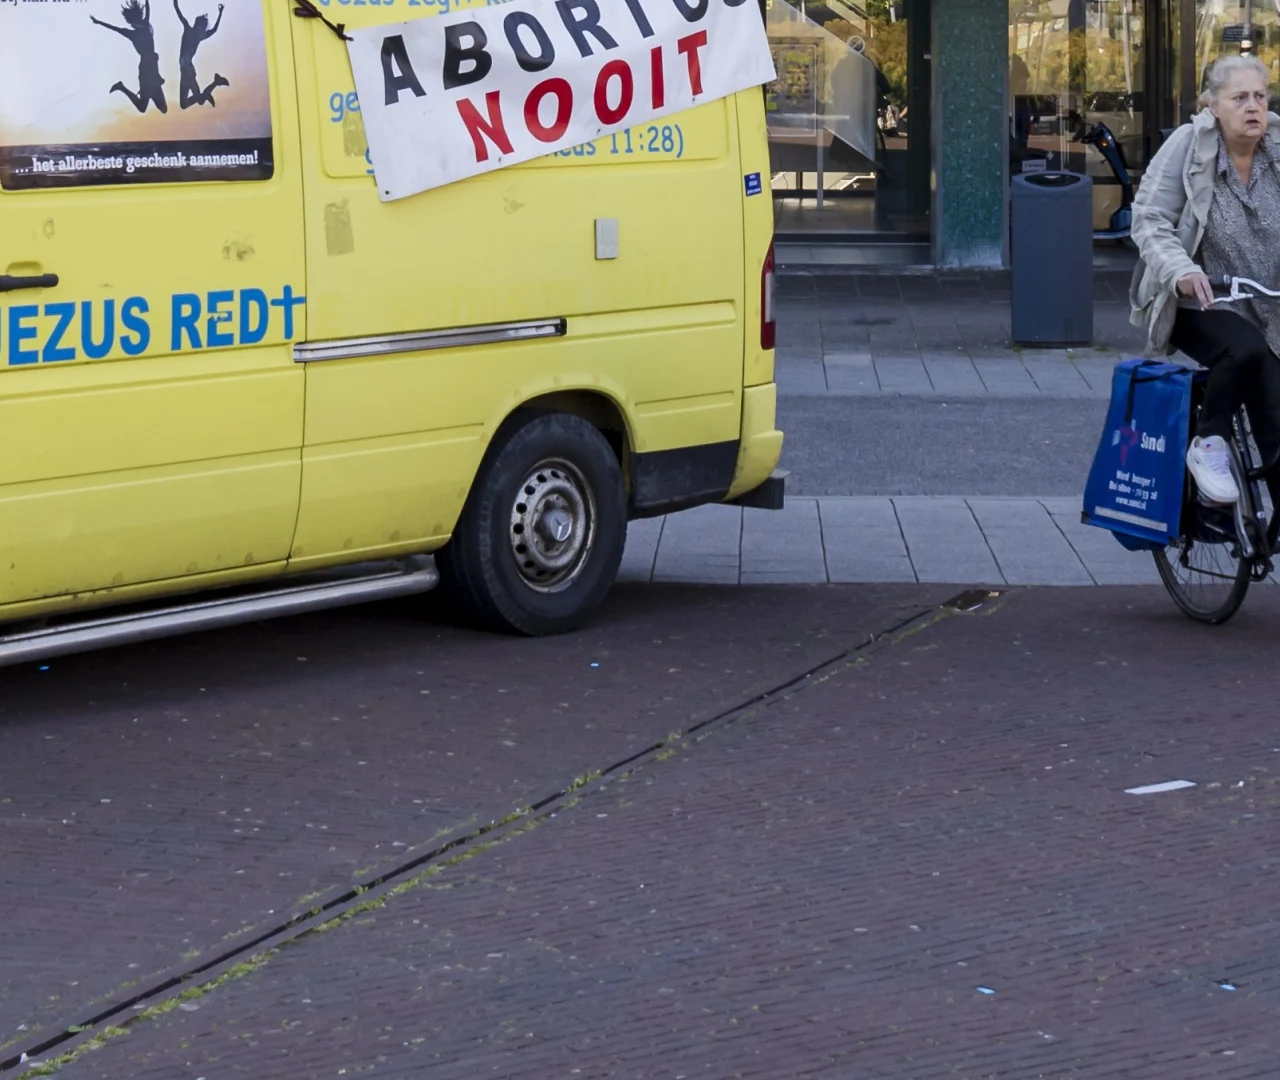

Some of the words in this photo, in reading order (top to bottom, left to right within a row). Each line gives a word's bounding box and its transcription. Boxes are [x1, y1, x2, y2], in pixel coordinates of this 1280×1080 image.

[456, 29, 709, 163] NOOIT
[32, 157, 55, 172] het
[58, 154, 124, 170] allerbeste
[126, 151, 187, 173] geschenk
[189, 150, 259, 166] aannemen!
